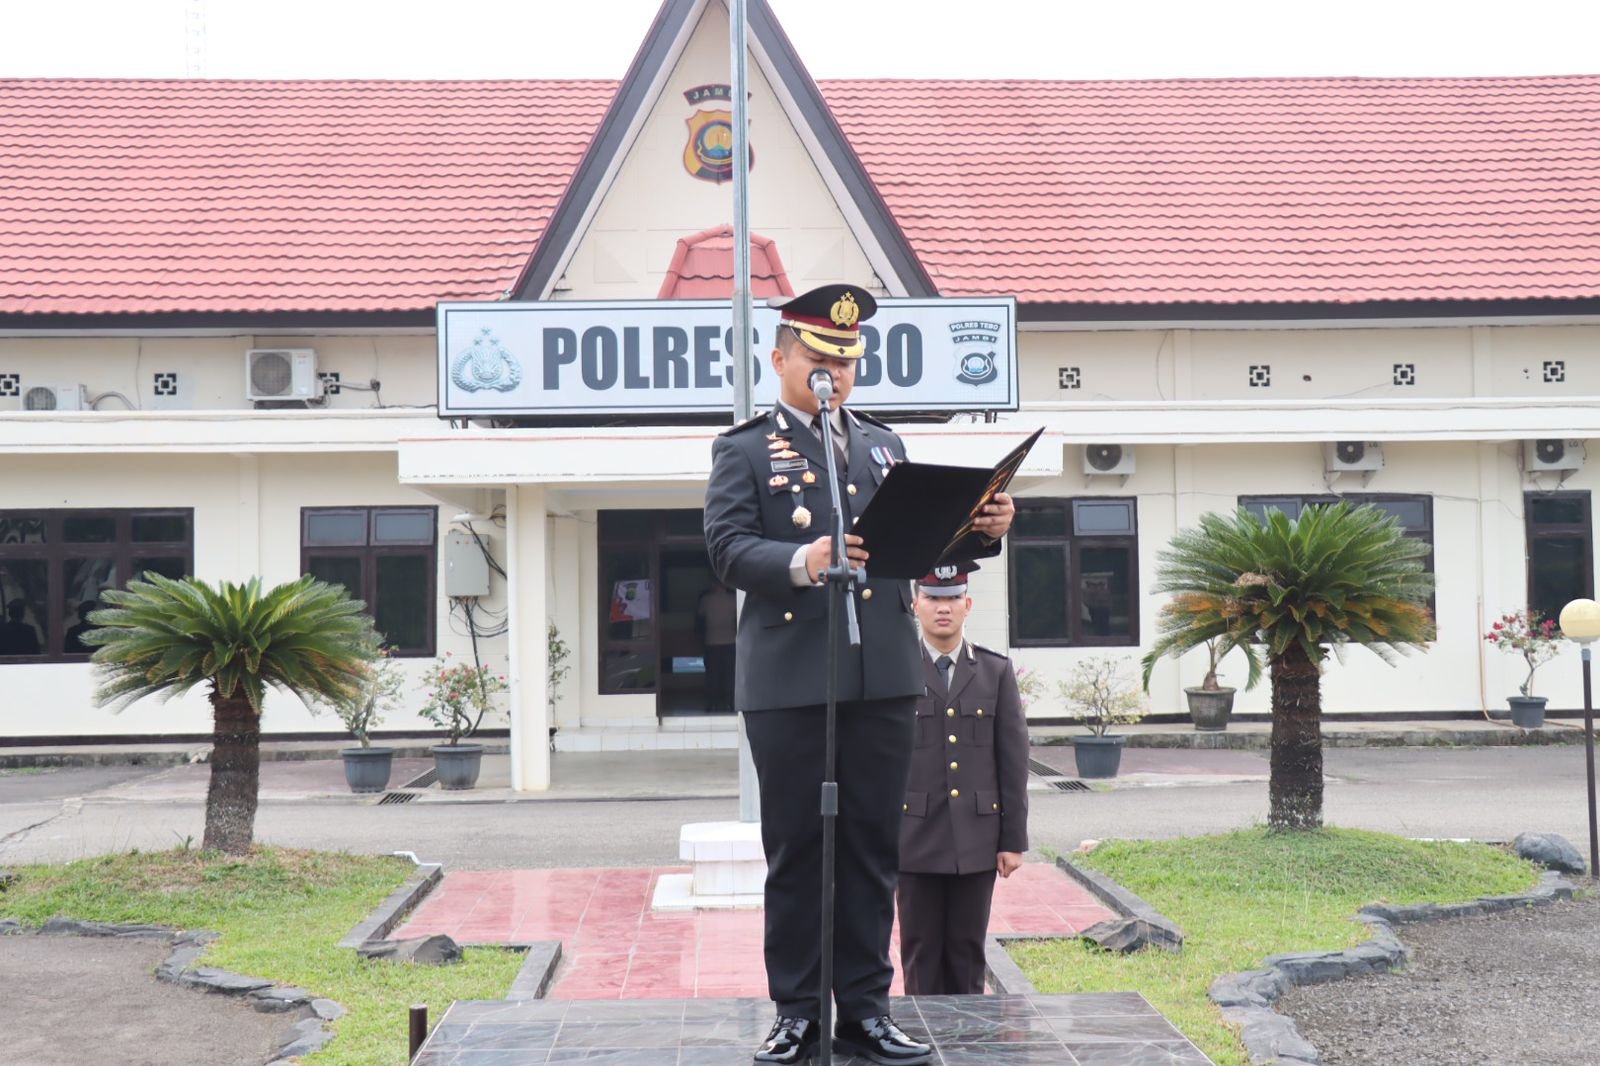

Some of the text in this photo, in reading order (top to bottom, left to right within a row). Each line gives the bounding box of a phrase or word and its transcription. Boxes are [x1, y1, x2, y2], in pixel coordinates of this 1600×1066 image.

[693, 88, 731, 100] JAM
[951, 322, 999, 331] POLRES TEBO
